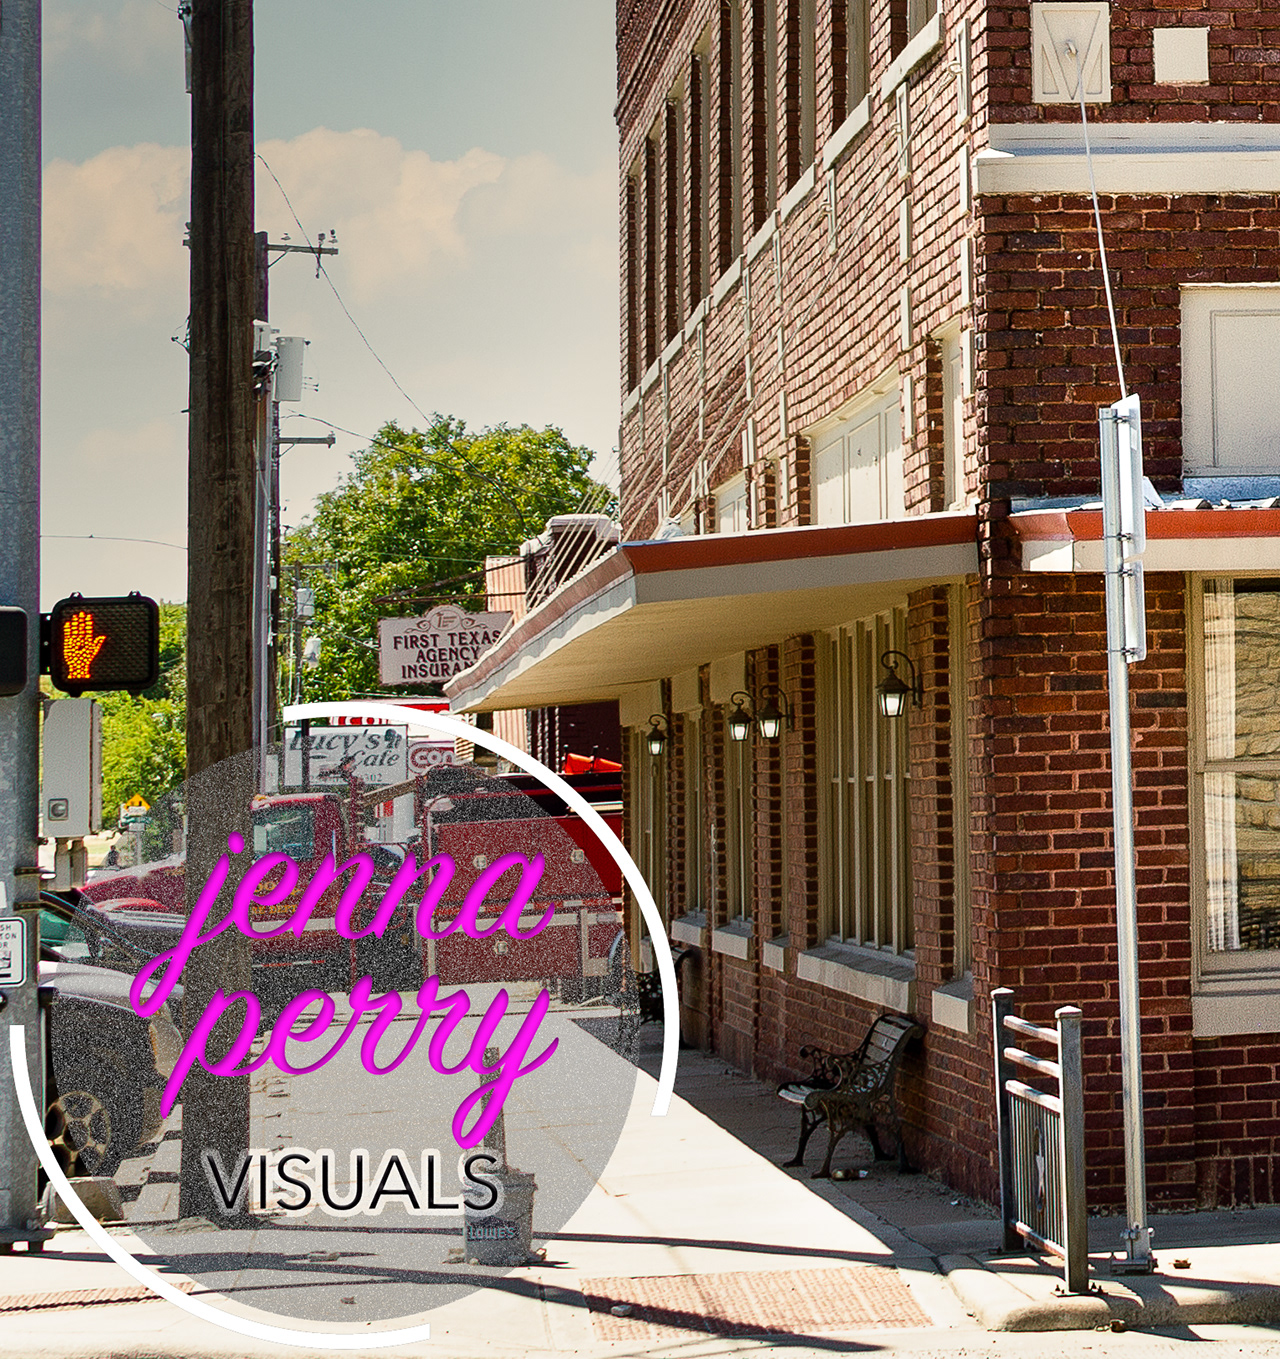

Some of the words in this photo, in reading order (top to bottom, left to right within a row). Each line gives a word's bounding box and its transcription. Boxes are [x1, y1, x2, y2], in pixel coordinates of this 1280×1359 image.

[393, 633, 440, 650] FIRST
[447, 630, 502, 647] TEXAS
[416, 646, 480, 663] AGENCY
[289, 729, 382, 755] Lucy's
